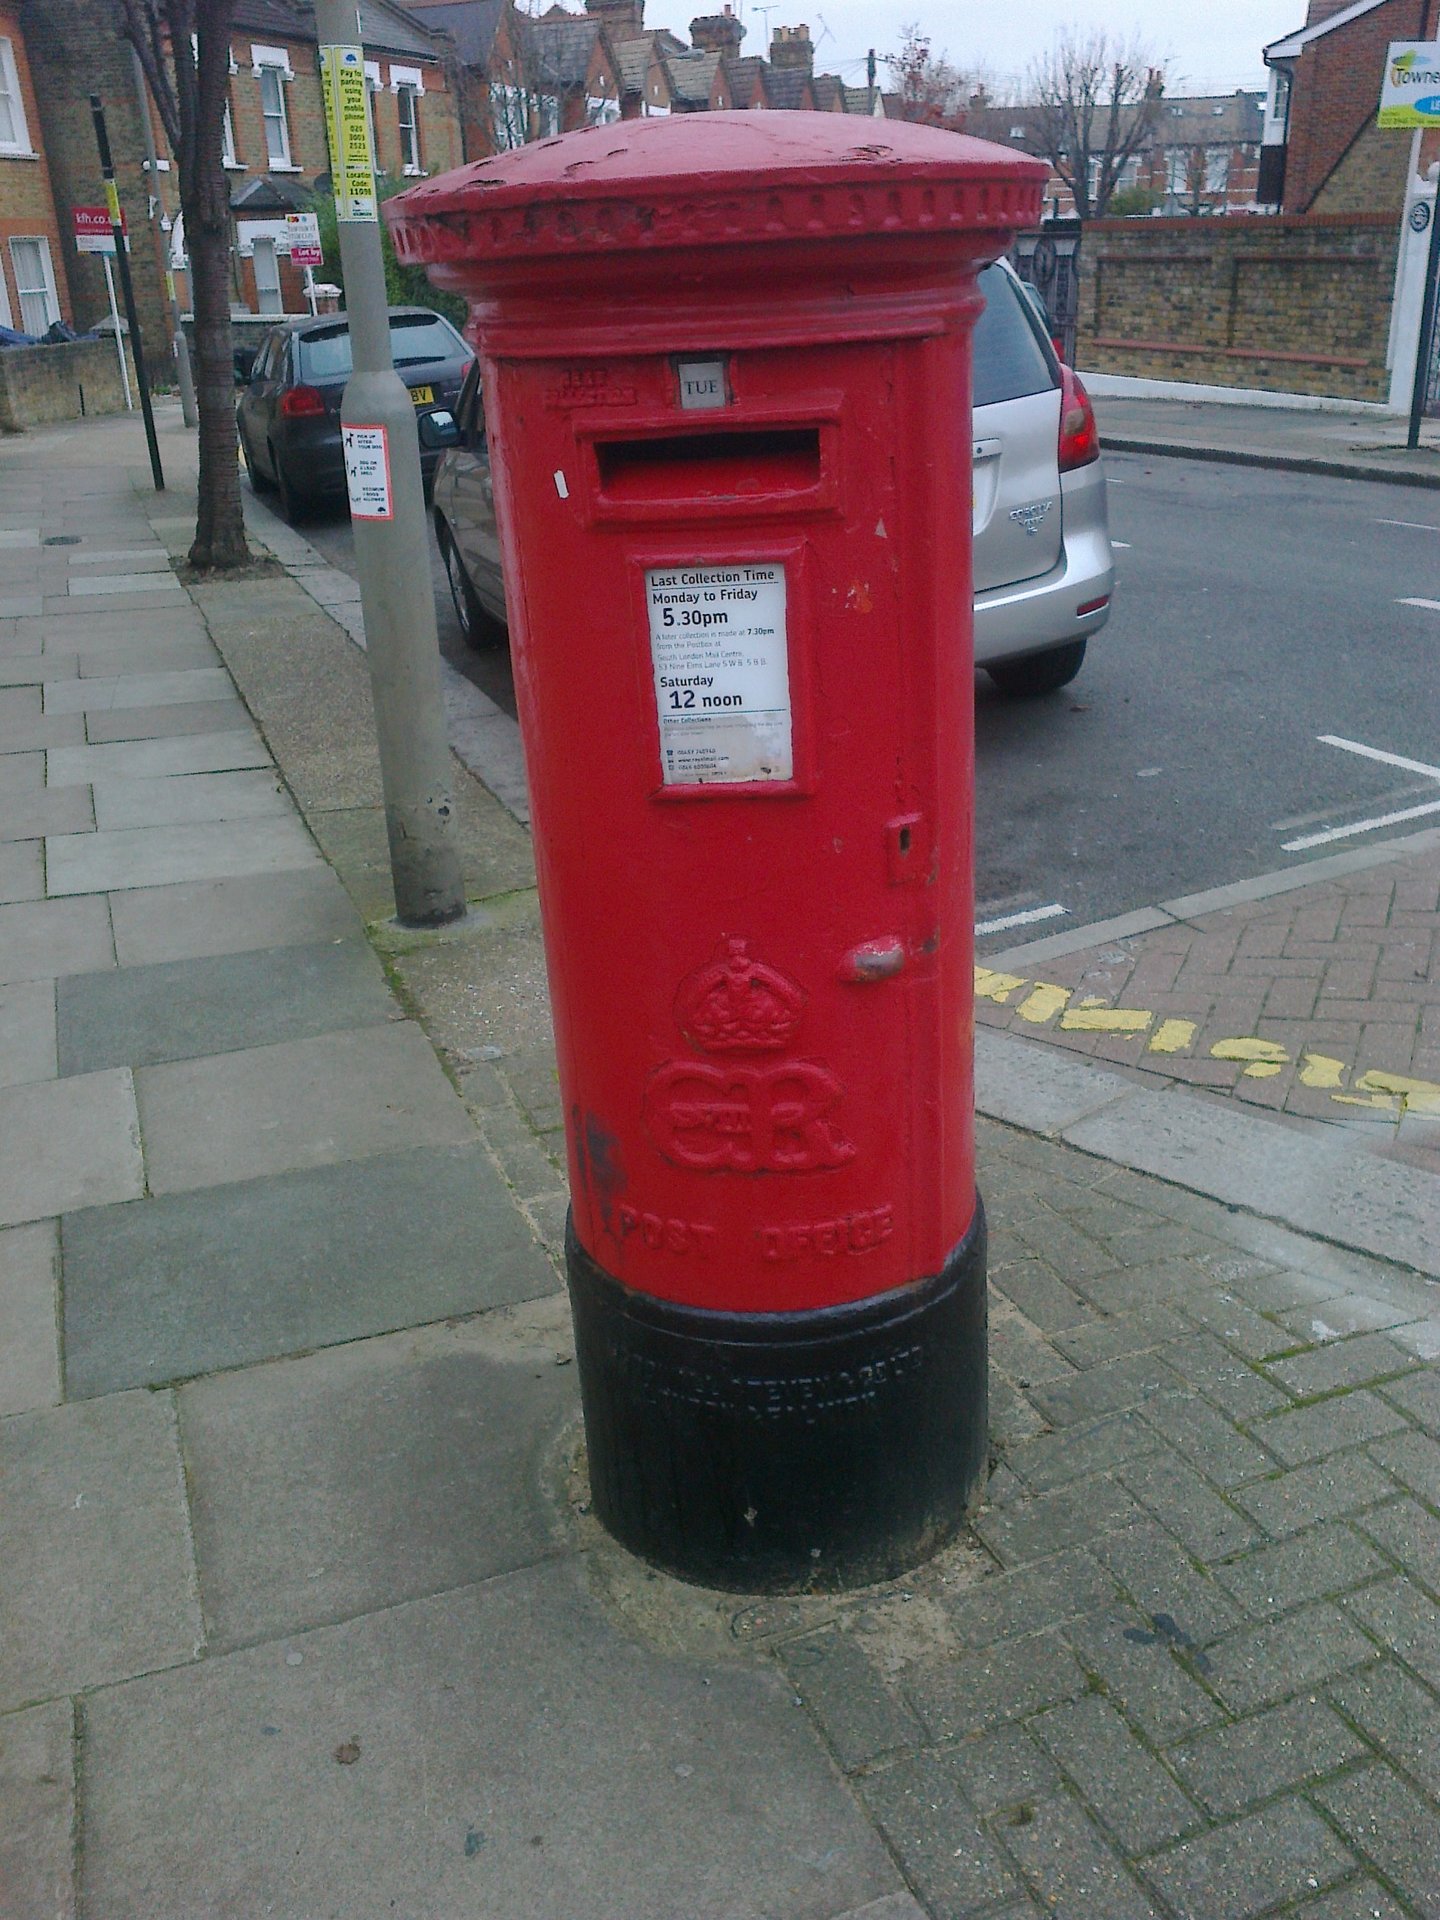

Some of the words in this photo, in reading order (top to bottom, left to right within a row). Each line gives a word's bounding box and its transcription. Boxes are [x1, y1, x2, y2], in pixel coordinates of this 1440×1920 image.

[340, 69, 352, 78] Pay
[340, 79, 363, 87] parking
[345, 88, 362, 96] using
[684, 379, 719, 395] TUE
[651, 575, 678, 587] Last
[681, 571, 740, 585] Collection
[743, 569, 775, 581] Time
[652, 592, 700, 605] Monday
[704, 591, 716, 602] to
[720, 588, 758, 601] Friday
[663, 607, 729, 628] 5.30pm
[660, 675, 714, 688] Saturday
[669, 689, 696, 709] 12
[702, 694, 742, 707] noon
